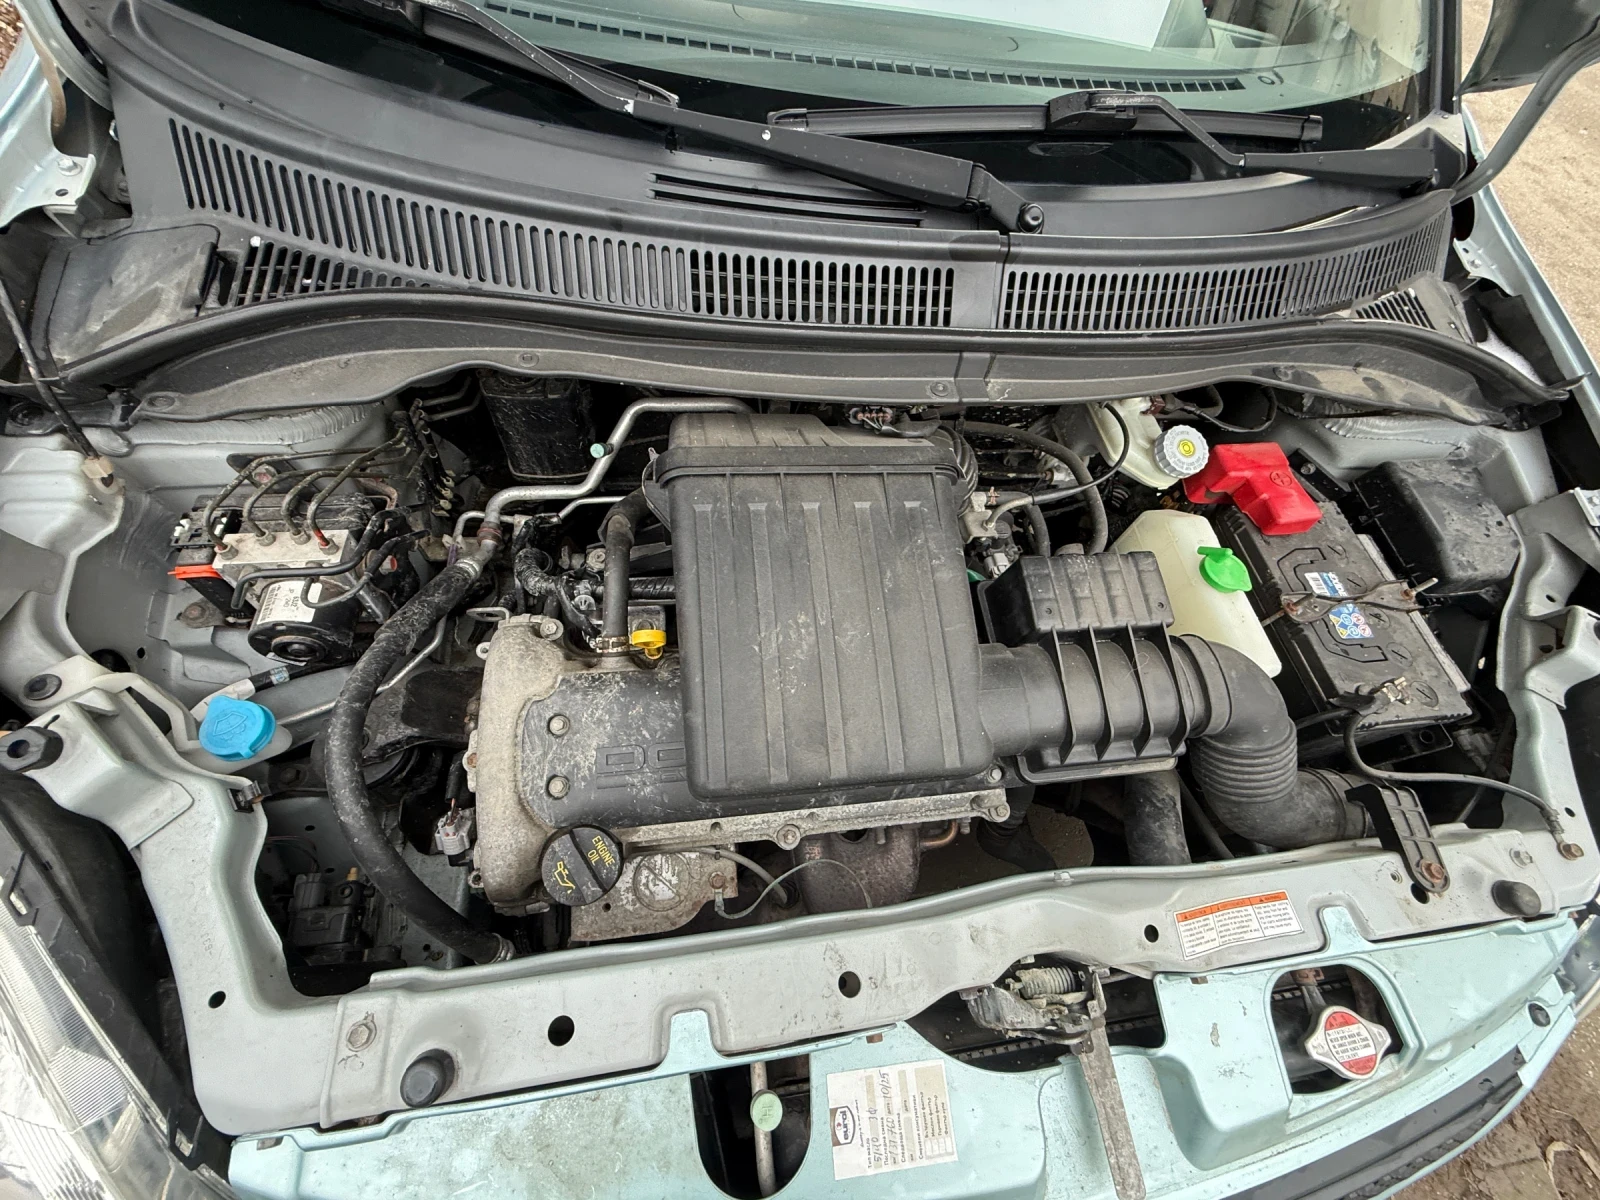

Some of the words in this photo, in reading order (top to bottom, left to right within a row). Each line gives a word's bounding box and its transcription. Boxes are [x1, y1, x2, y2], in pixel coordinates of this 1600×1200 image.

[588, 850, 600, 866] OIL
[592, 835, 615, 867] ENGINE
[878, 1069, 892, 1099] 10/25
[840, 1110, 849, 1140] eurol
